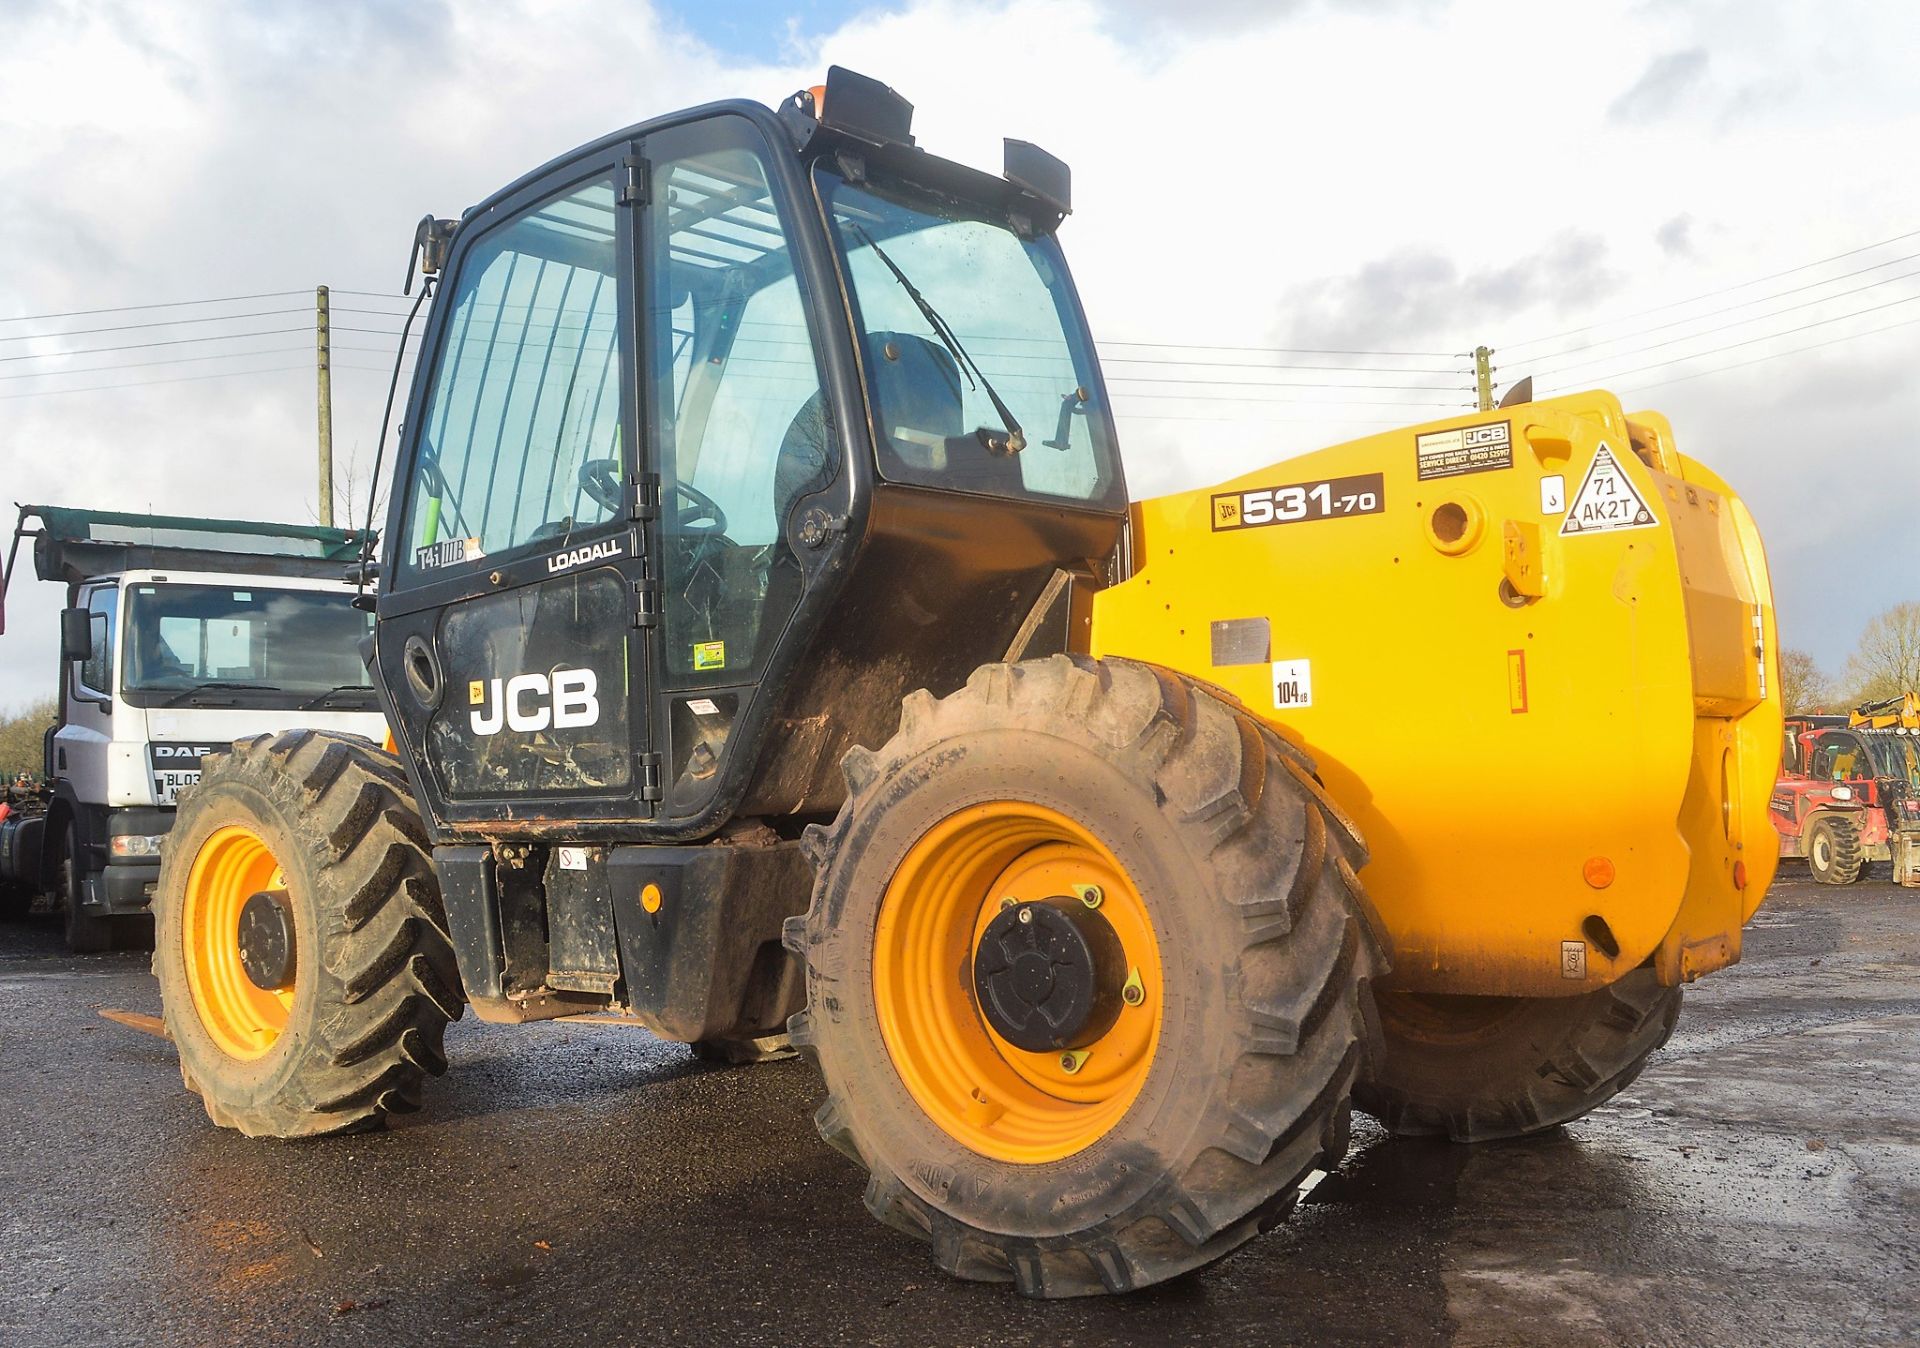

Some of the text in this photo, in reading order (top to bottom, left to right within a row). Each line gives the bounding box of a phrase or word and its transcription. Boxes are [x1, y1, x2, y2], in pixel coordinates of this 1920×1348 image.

[1465, 426, 1506, 445] JCB
[1419, 459, 1445, 469] SERVICE
[1445, 455, 1467, 465] DIRECT
[1593, 477, 1616, 495] 71
[1219, 483, 1376, 524] JCB 531-70
[1583, 498, 1631, 521] AK2T
[547, 539, 622, 573] LOADALL
[469, 668, 600, 736] JCB
[1277, 681, 1299, 704] 104
[155, 746, 211, 757] DAF
[167, 773, 201, 786] BL03
